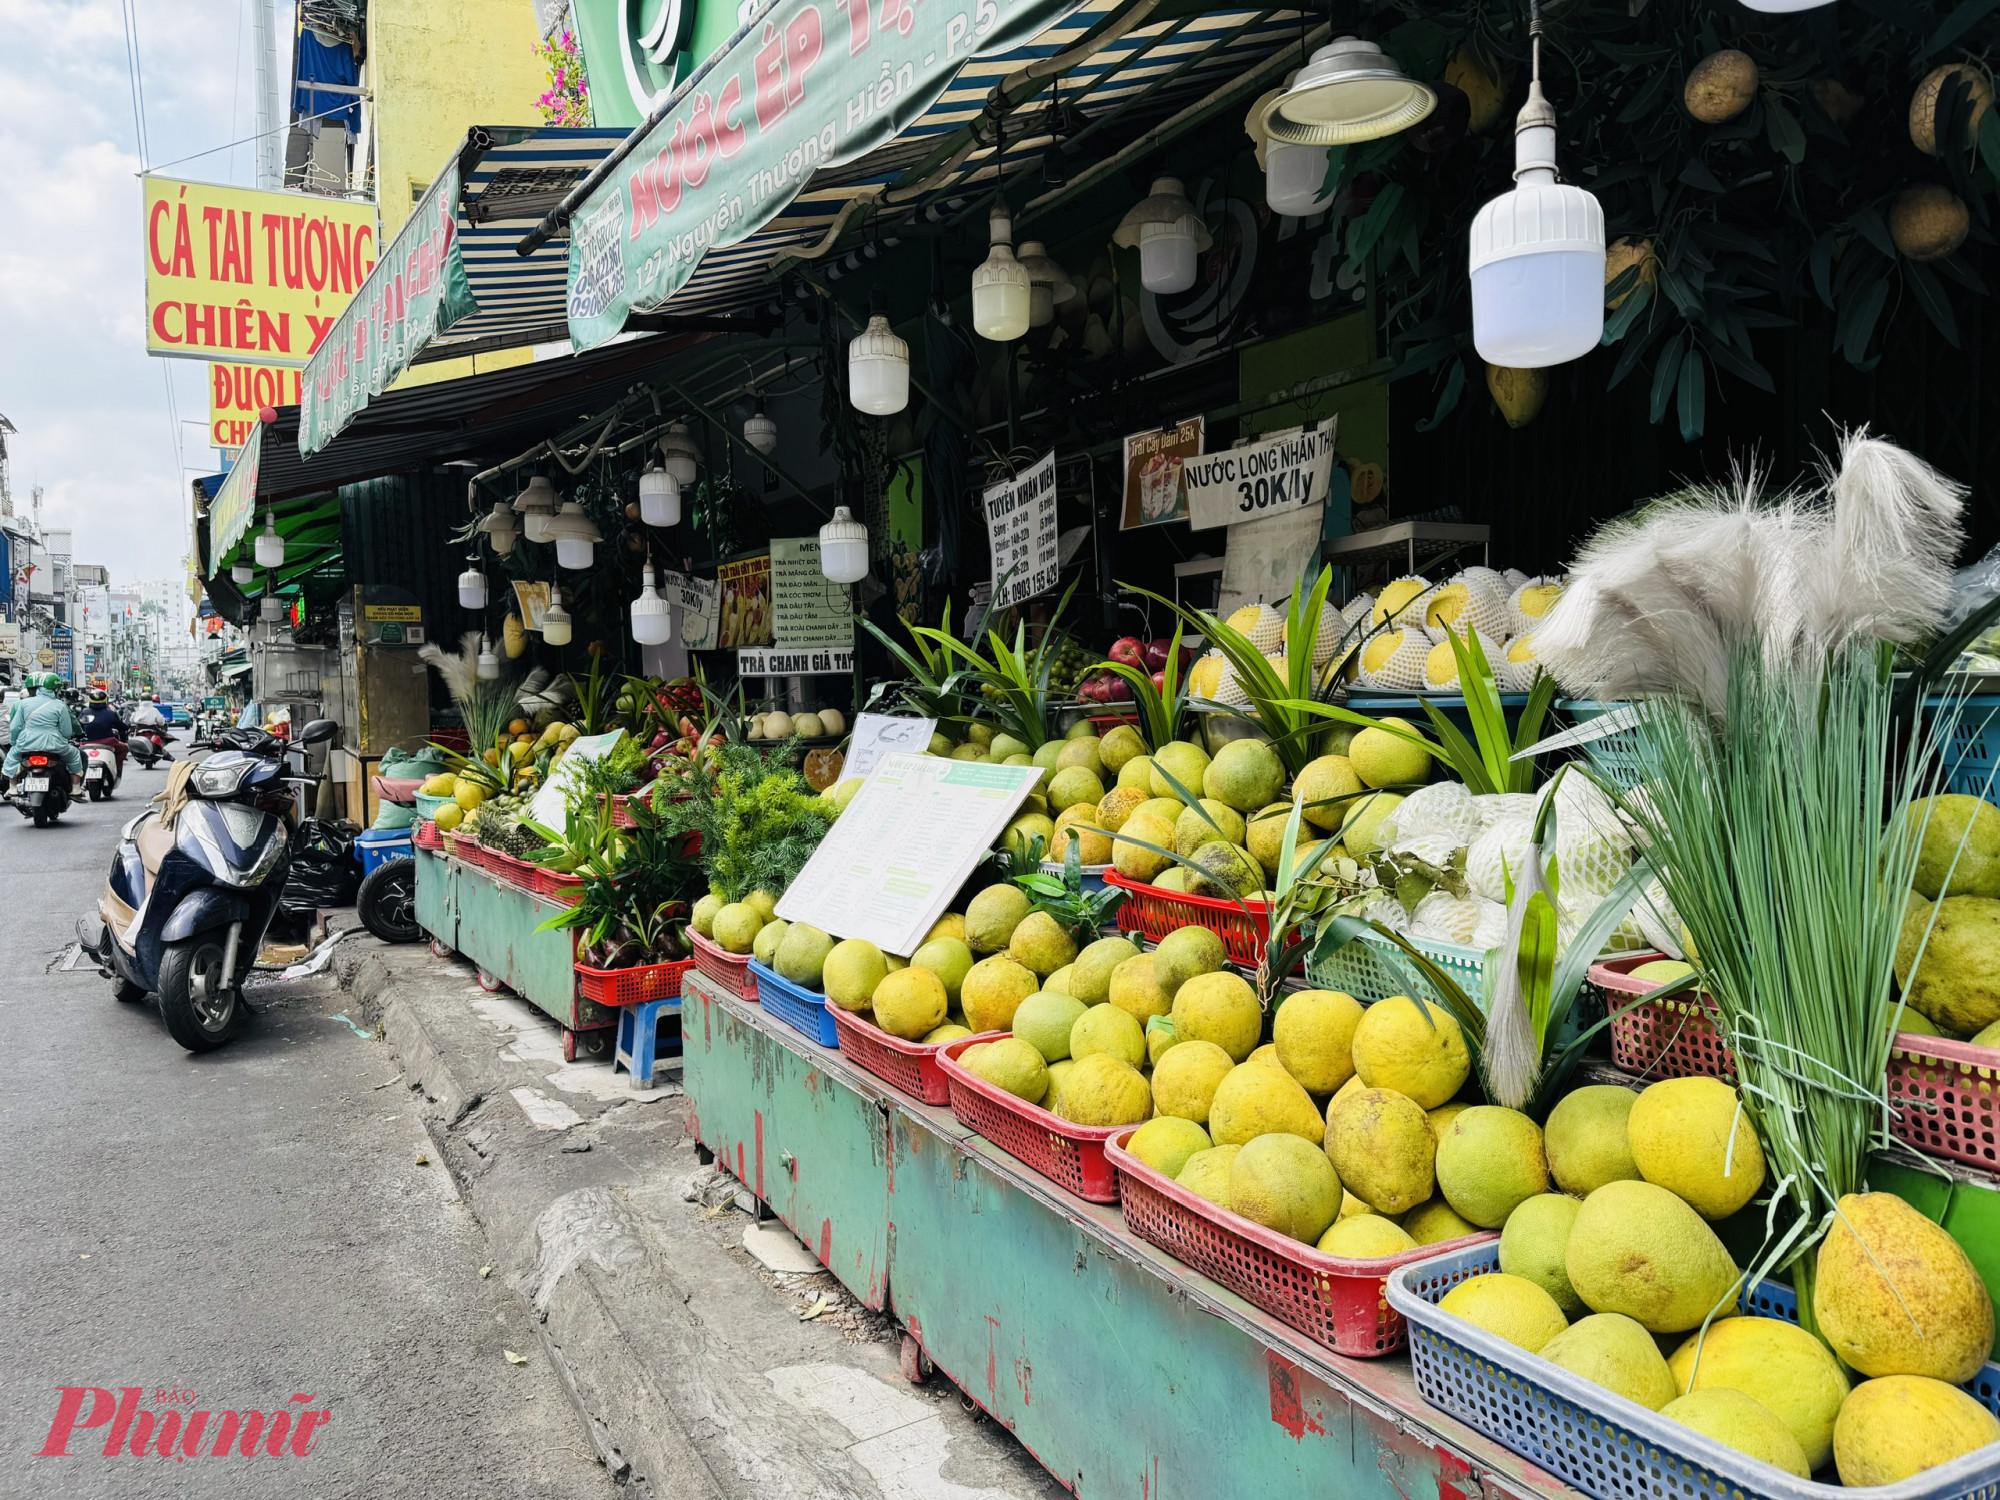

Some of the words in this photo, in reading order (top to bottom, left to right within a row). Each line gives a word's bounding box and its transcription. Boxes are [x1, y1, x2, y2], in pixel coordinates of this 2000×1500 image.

[629, 73, 746, 244] NƯỚC
[753, 5, 824, 136] ÉP
[635, 248, 662, 291] 127
[668, 192, 744, 268] Nguyễn
[748, 120, 837, 184] Thượng
[846, 60, 914, 135] Hiền
[945, 0, 998, 60] P.5
[150, 185, 196, 279] CÁ
[203, 206, 253, 284] TAI
[262, 213, 375, 308] TƯỢNG
[153, 298, 291, 354] CHIÊN
[1180, 425, 1195, 443] 25k
[1185, 457, 1236, 489] NƯỚC
[1240, 448, 1277, 479] LONG
[1281, 434, 1316, 469] NHÃN
[988, 486, 1015, 521] TUYỂN
[1017, 476, 1038, 508] NHÂN
[1039, 463, 1054, 494] VIÊN
[1238, 468, 1314, 513] 30K/ly
[800, 544, 821, 552] MEN
[998, 587, 1011, 608] LH:
[1012, 577, 1031, 602] 0903
[1032, 571, 1045, 594] 155
[1047, 562, 1057, 586] 429
[740, 651, 765, 673] TRÀ
[770, 655, 808, 672] CHANH
